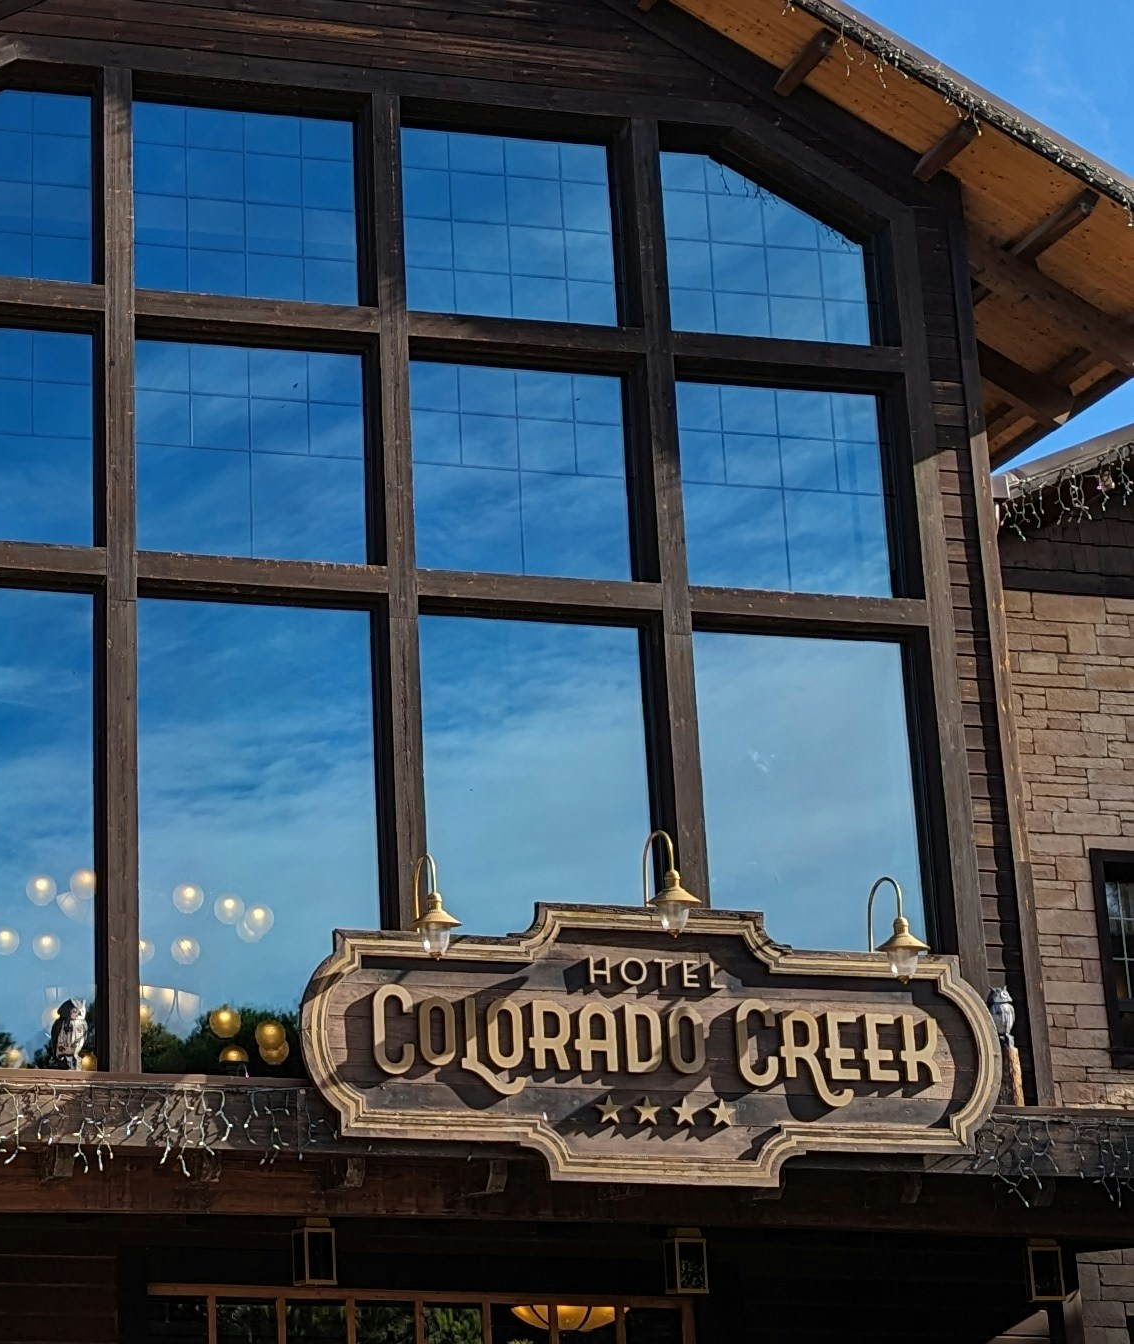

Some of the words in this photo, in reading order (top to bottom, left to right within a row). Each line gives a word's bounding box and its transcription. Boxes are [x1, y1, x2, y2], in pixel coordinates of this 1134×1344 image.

[588, 955, 727, 989] HOTEL
[373, 984, 706, 1095] COLORADO
[735, 998, 943, 1107] CREEK
